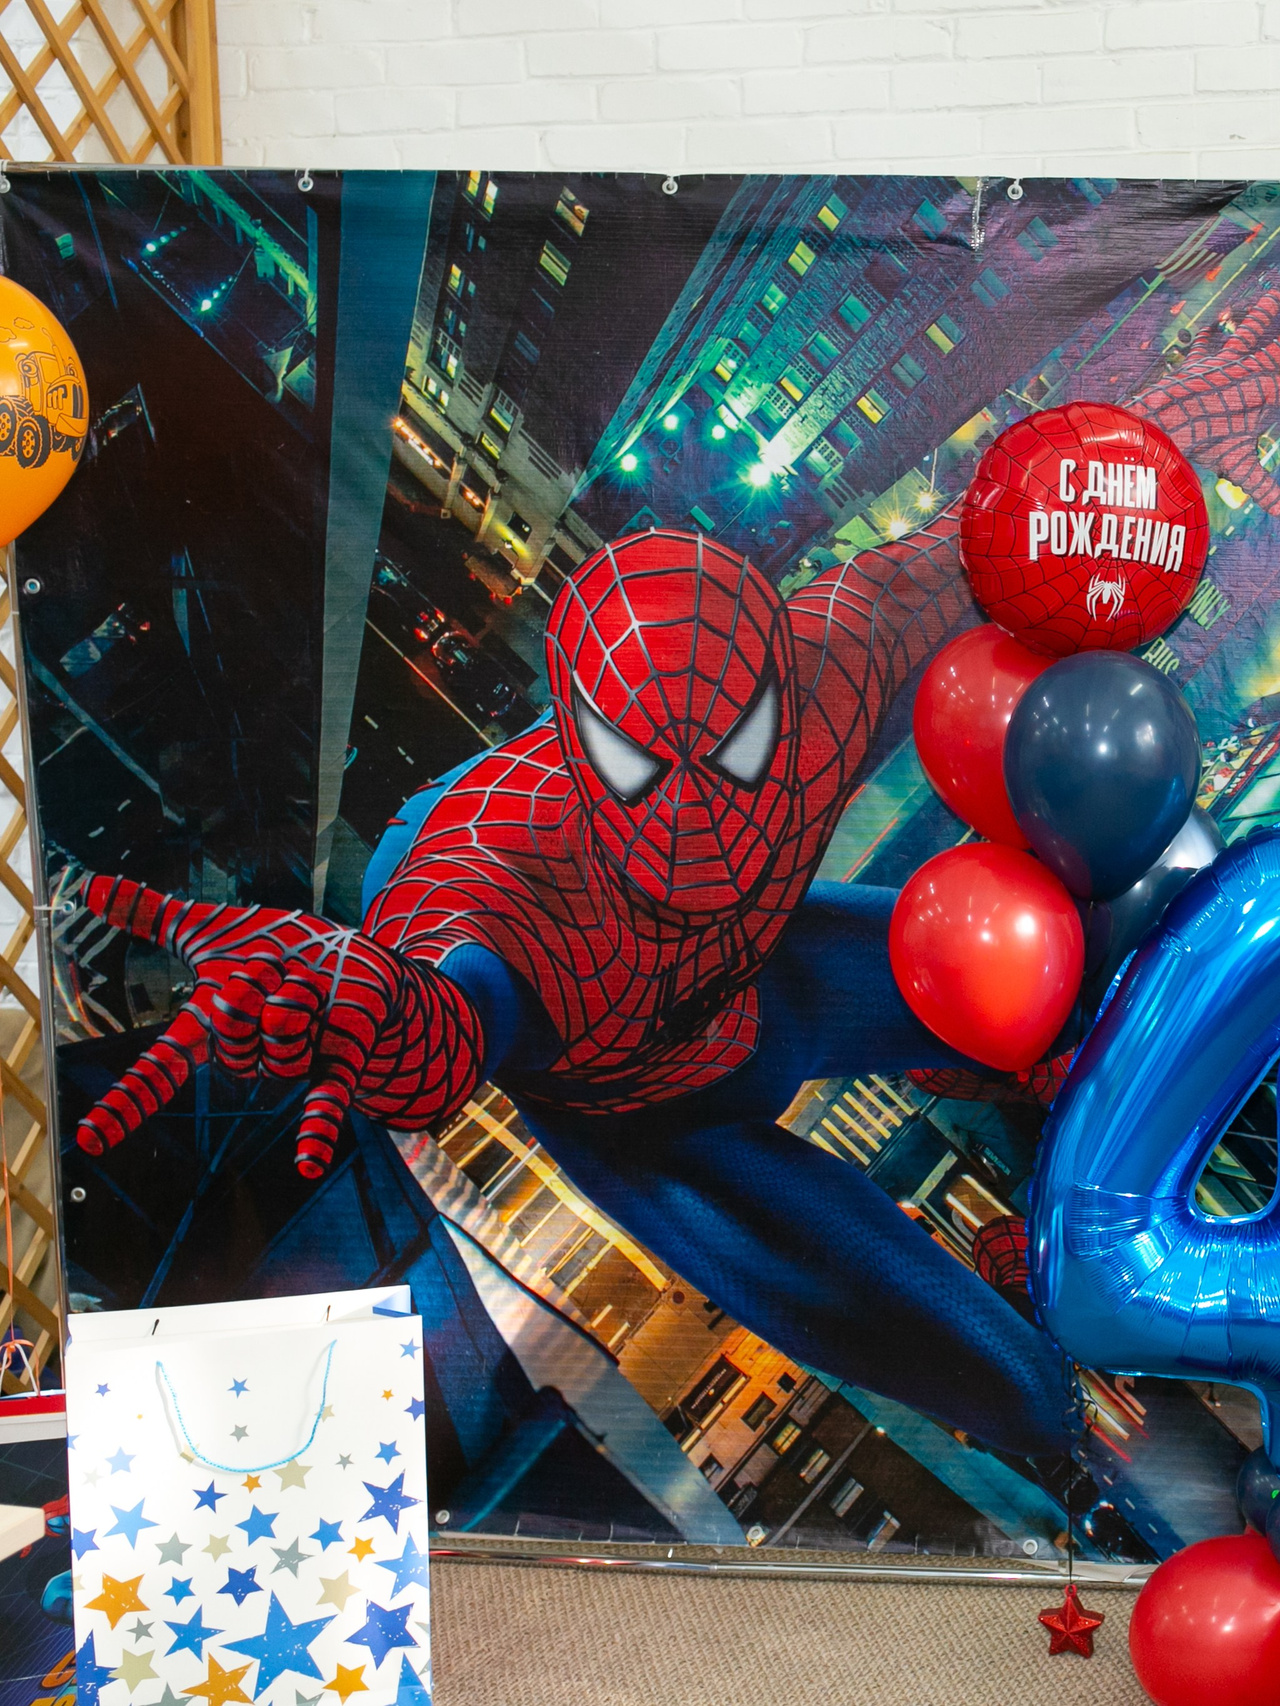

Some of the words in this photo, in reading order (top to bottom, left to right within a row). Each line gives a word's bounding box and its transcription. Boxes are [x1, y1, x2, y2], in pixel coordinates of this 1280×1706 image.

[1059, 458, 1077, 503] С
[1082, 456, 1158, 510] ДНЁМ
[1028, 510, 1186, 573] РОЖДЕНИЯ
